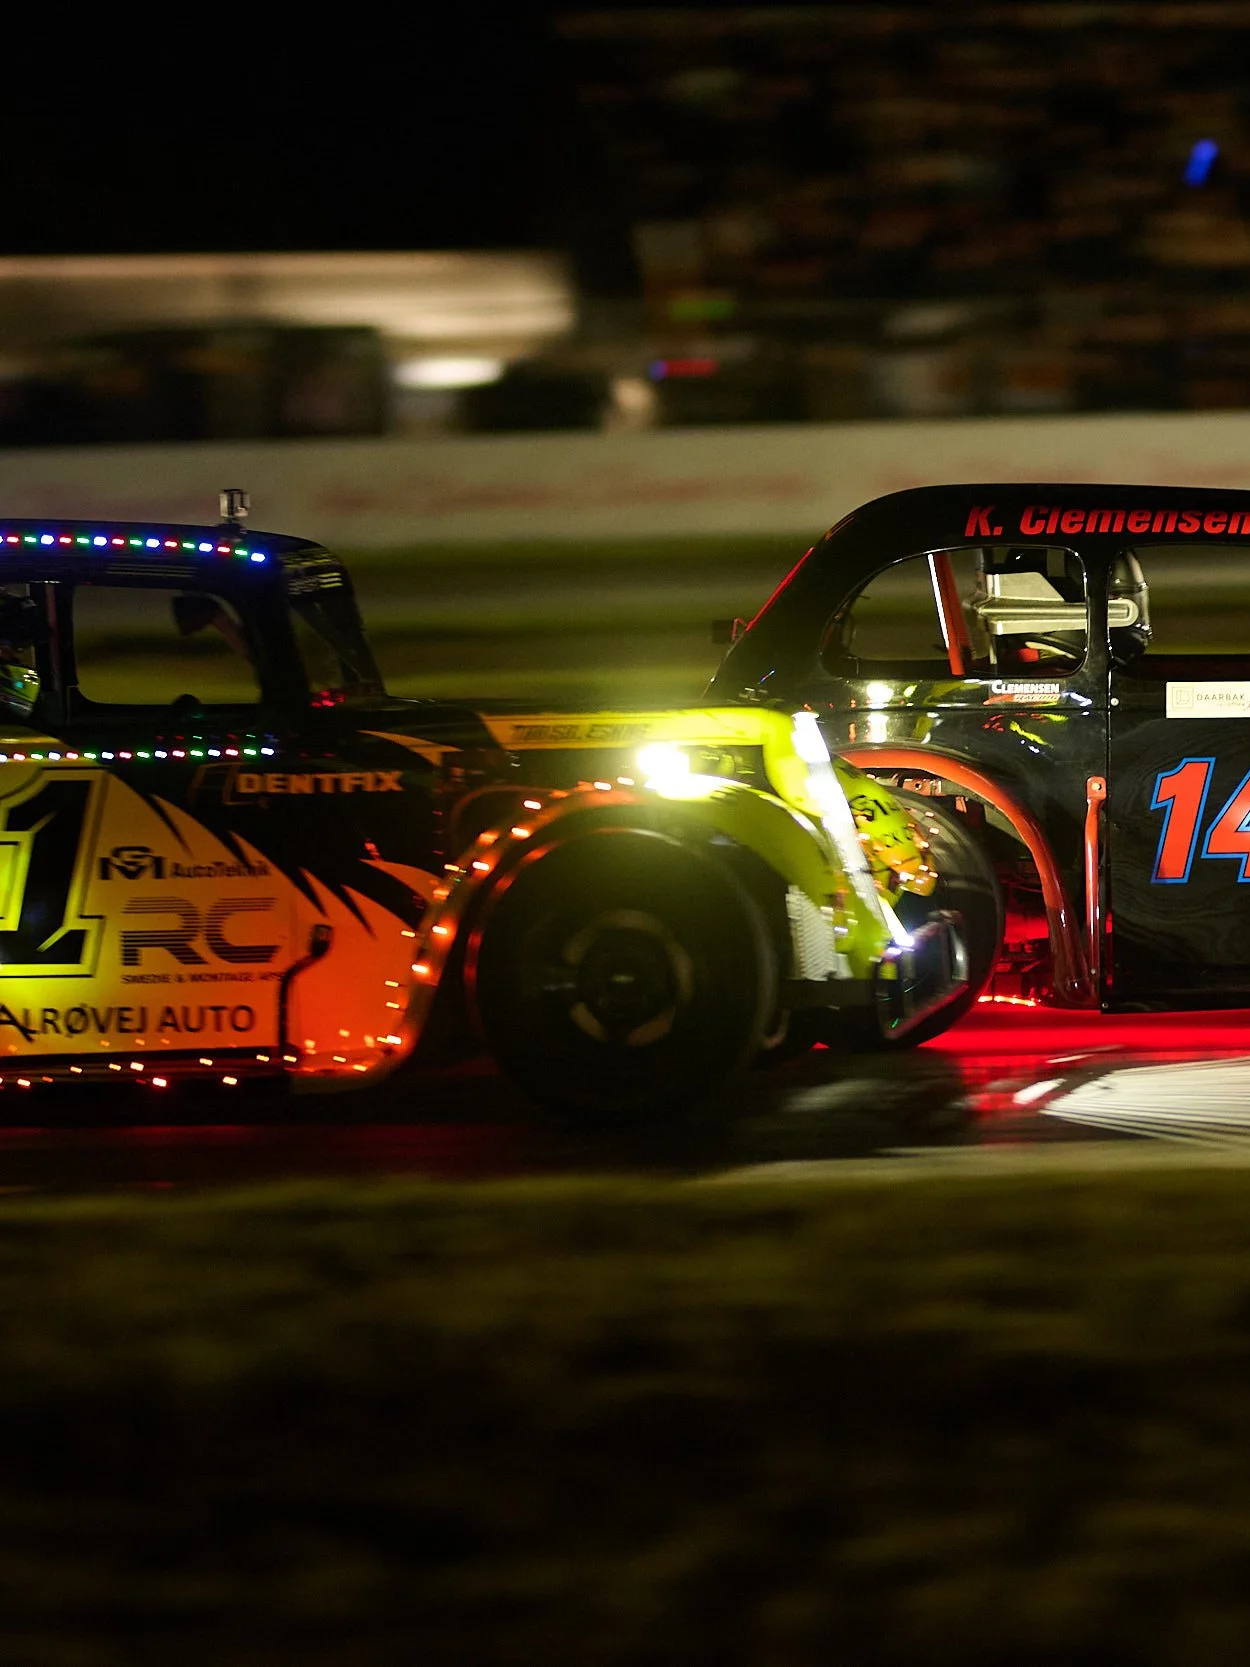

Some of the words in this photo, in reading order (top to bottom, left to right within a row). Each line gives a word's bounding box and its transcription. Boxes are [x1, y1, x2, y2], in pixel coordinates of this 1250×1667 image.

[963, 505, 1005, 538] K.
[1196, 693, 1246, 702] DAARBAK
[235, 770, 404, 795] DENTFIX
[120, 896, 281, 967] RC
[159, 1004, 256, 1033] AUTO
